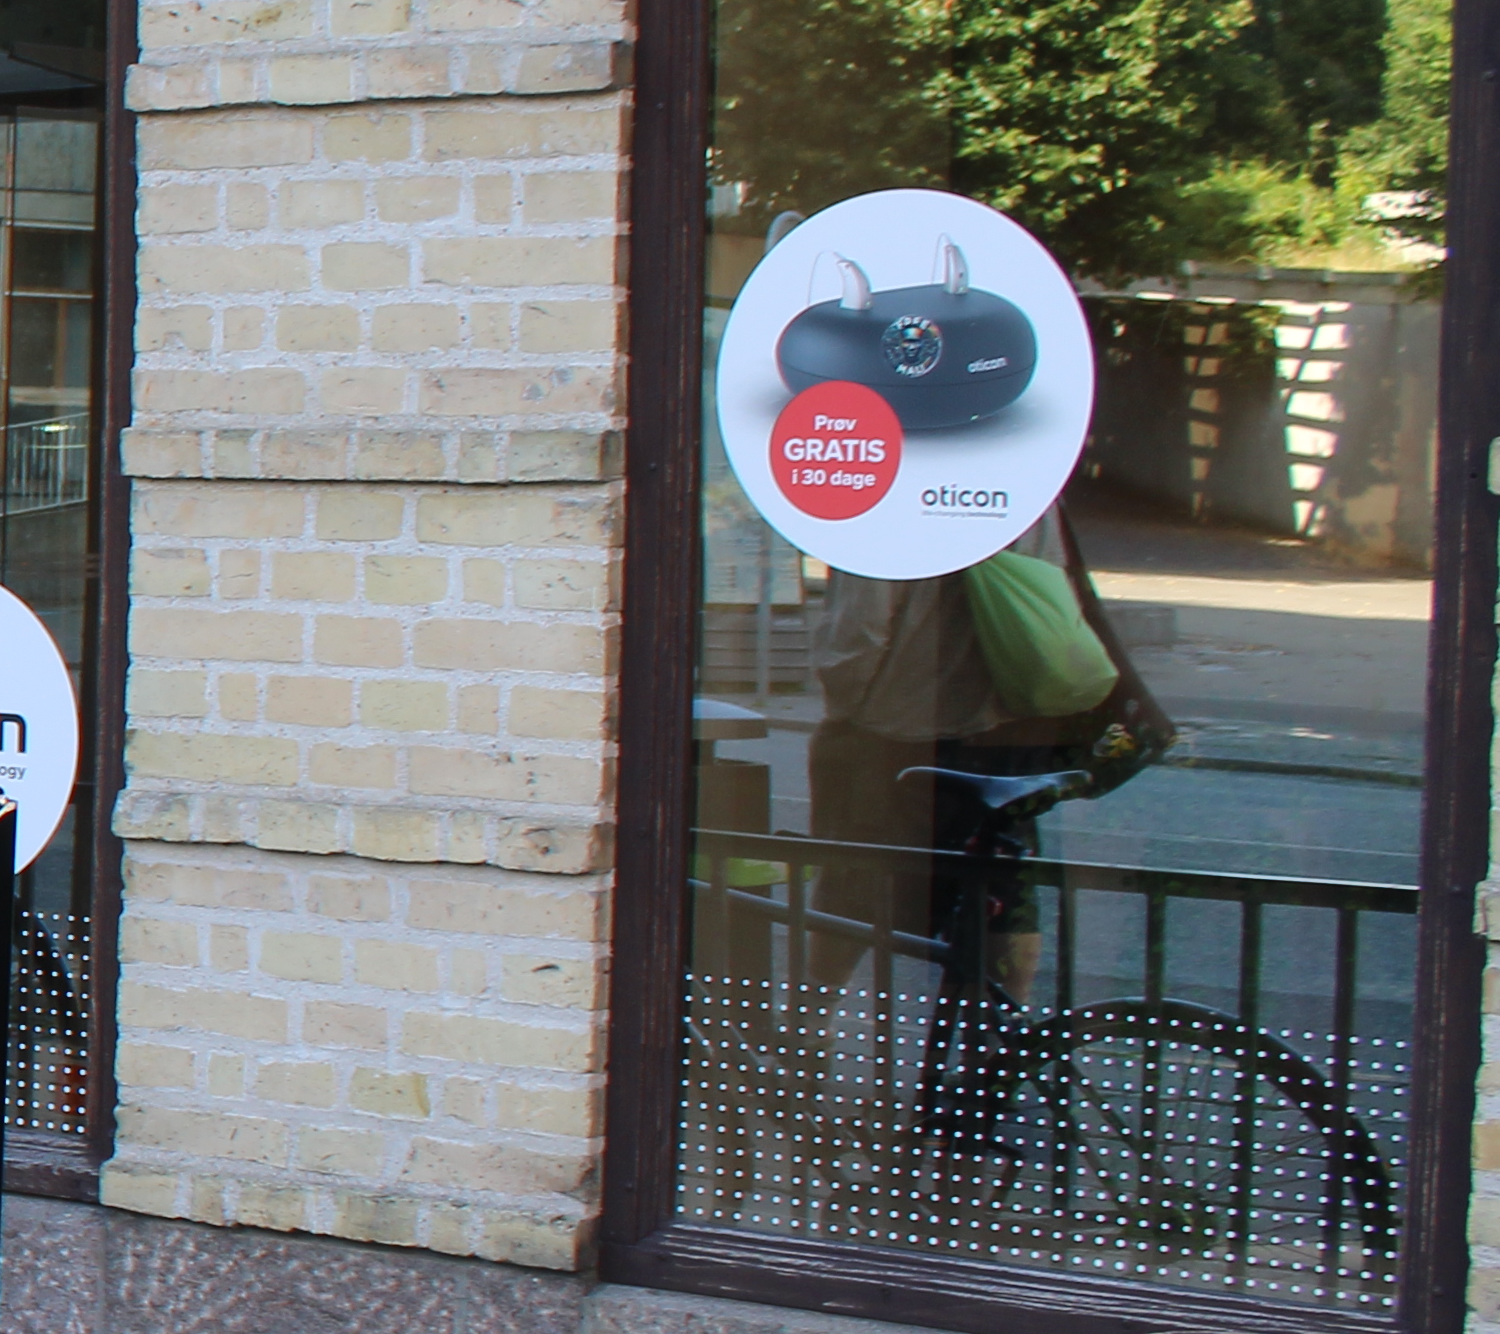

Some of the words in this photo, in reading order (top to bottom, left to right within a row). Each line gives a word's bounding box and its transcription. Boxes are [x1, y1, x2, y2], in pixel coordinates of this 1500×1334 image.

[967, 357, 1008, 374] oticon
[814, 414, 857, 432] Prøv
[784, 438, 886, 463] GRATIS
[791, 469, 798, 485] i
[801, 470, 826, 485] 30
[830, 469, 876, 491] dage
[921, 483, 1008, 508] oticon
